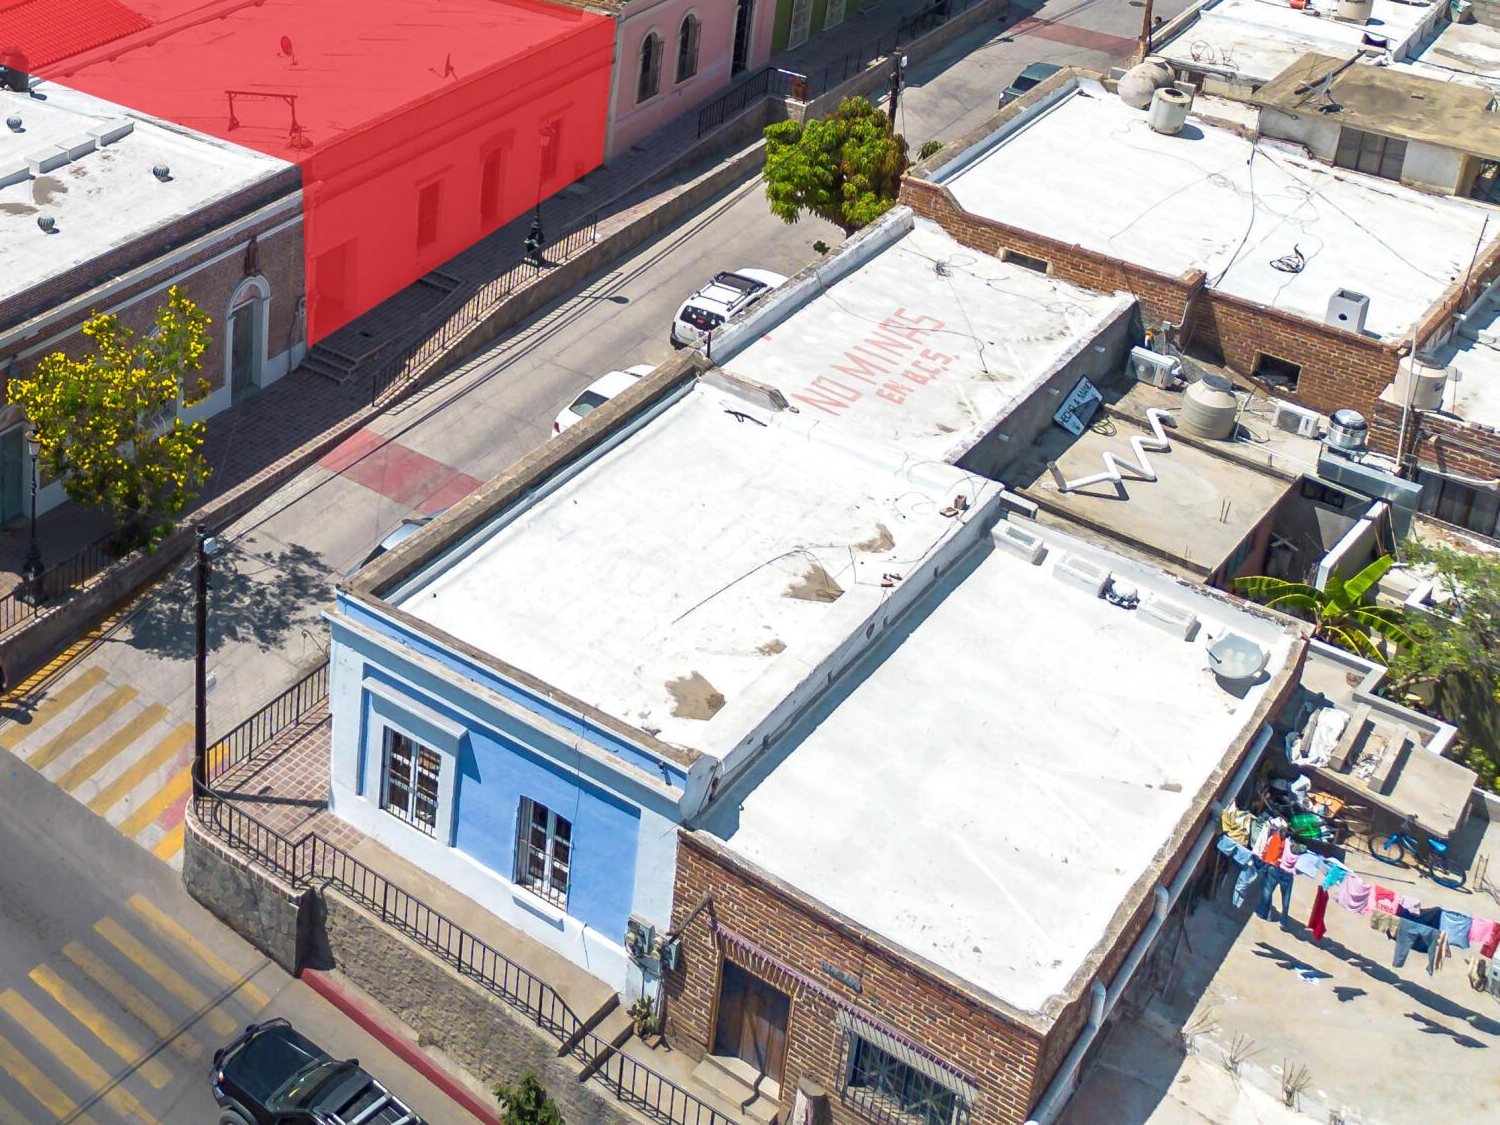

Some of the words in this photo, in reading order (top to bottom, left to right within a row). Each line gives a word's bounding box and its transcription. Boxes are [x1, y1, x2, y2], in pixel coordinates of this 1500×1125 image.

[790, 375, 863, 416] NO
[830, 307, 945, 385] MINAS
[875, 379, 915, 405] EN
